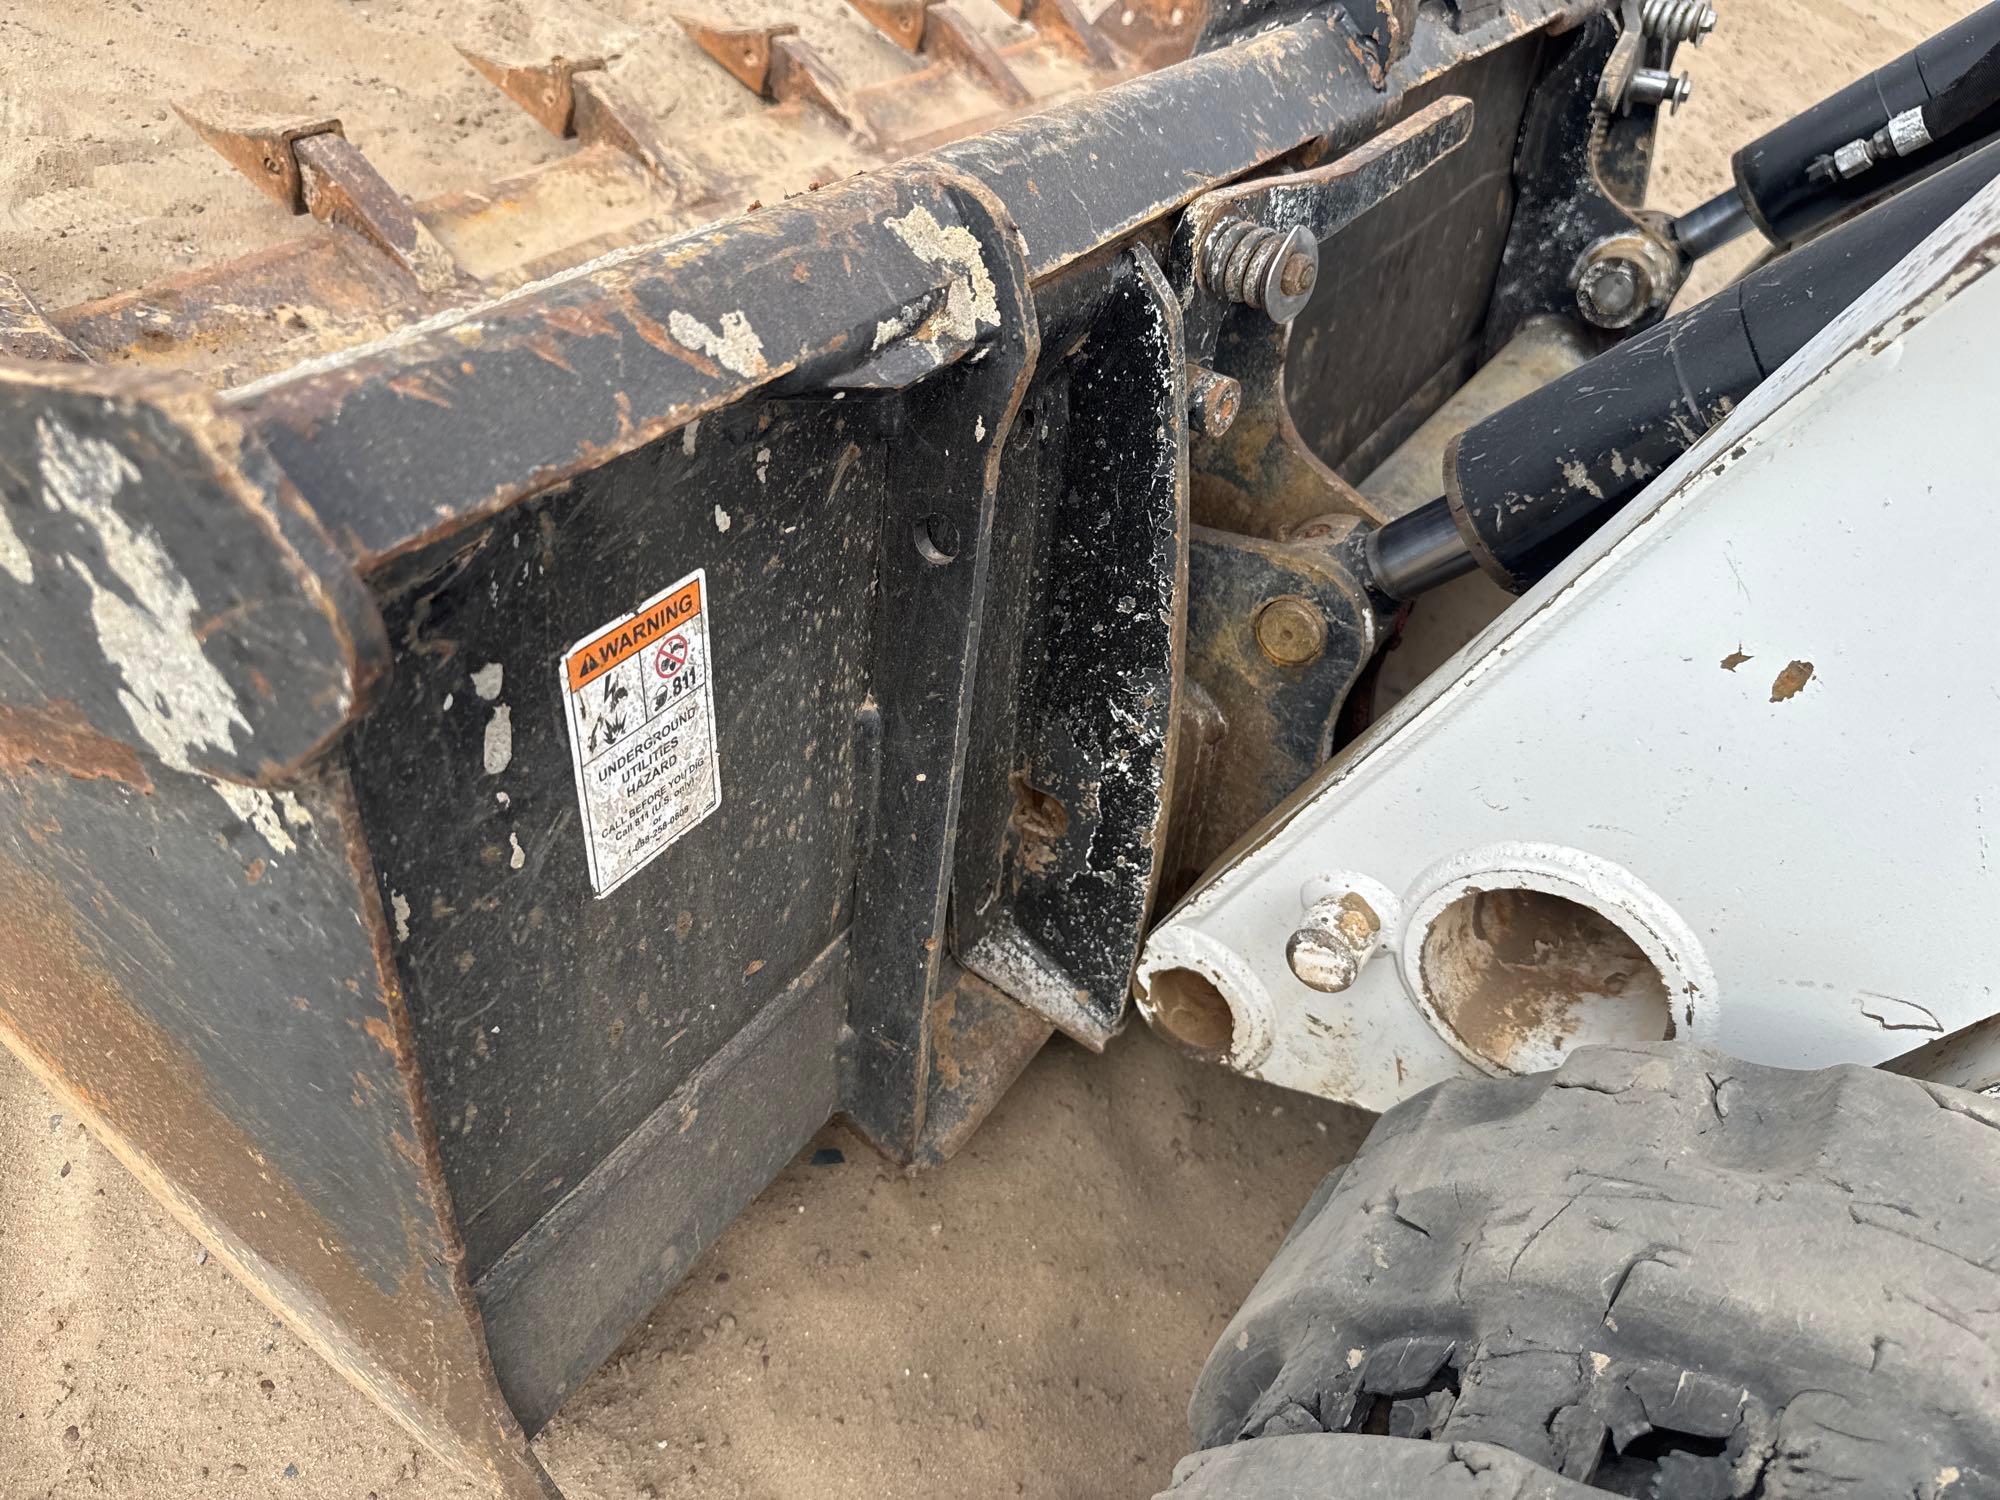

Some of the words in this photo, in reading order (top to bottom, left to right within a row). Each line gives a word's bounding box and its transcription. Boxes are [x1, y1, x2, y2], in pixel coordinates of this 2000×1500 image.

[599, 594, 693, 663] WARNING
[673, 666, 696, 697] 811
[598, 707, 696, 782] UNDERGROUND
[622, 736, 679, 784] UTILITIES
[601, 817, 627, 839] CALL
[629, 785, 666, 819] BEFORE
[668, 769, 687, 789] YOU
[689, 757, 704, 774] DIG
[627, 754, 678, 798] HAZARD
[615, 823, 633, 841] Call
[634, 811, 649, 827] 811
[652, 815, 663, 826] or
